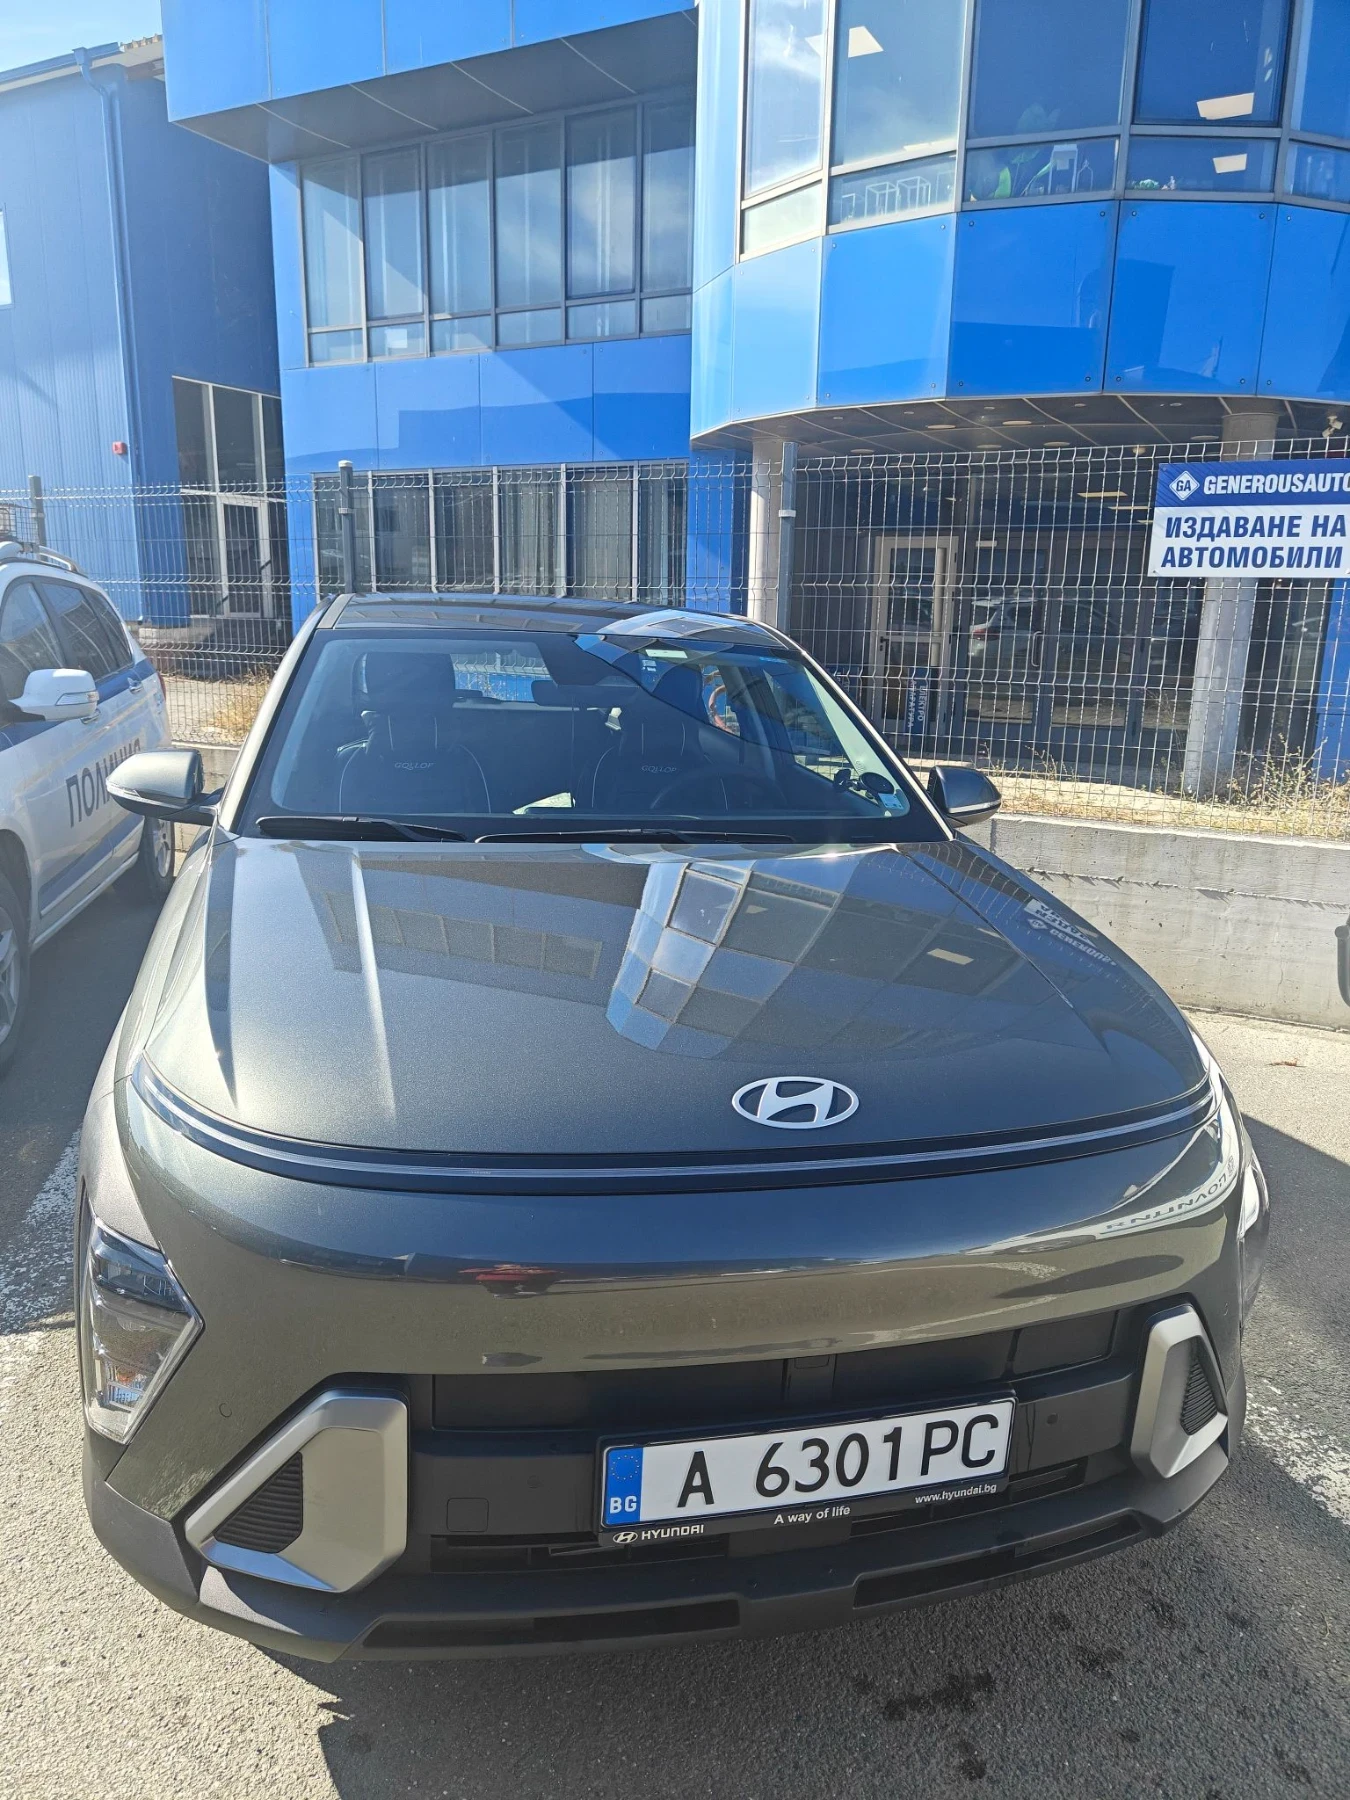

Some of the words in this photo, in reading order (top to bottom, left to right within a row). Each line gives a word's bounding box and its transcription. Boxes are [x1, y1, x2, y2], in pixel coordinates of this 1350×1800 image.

[1176, 480, 1192, 492] GA
[1165, 515, 1302, 542] ИЗДАВАНЕ
[1311, 514, 1346, 538] НА
[1161, 546, 1343, 569] АВТОМОБИЛИ
[915, 1484, 997, 1504] www.hyundai.bg
[610, 1496, 637, 1514] BG
[774, 1514, 784, 1524] A
[787, 1512, 812, 1524] way
[816, 1507, 830, 1520] of
[832, 1506, 850, 1518] life
[642, 1525, 704, 1540] HYUNDAI
